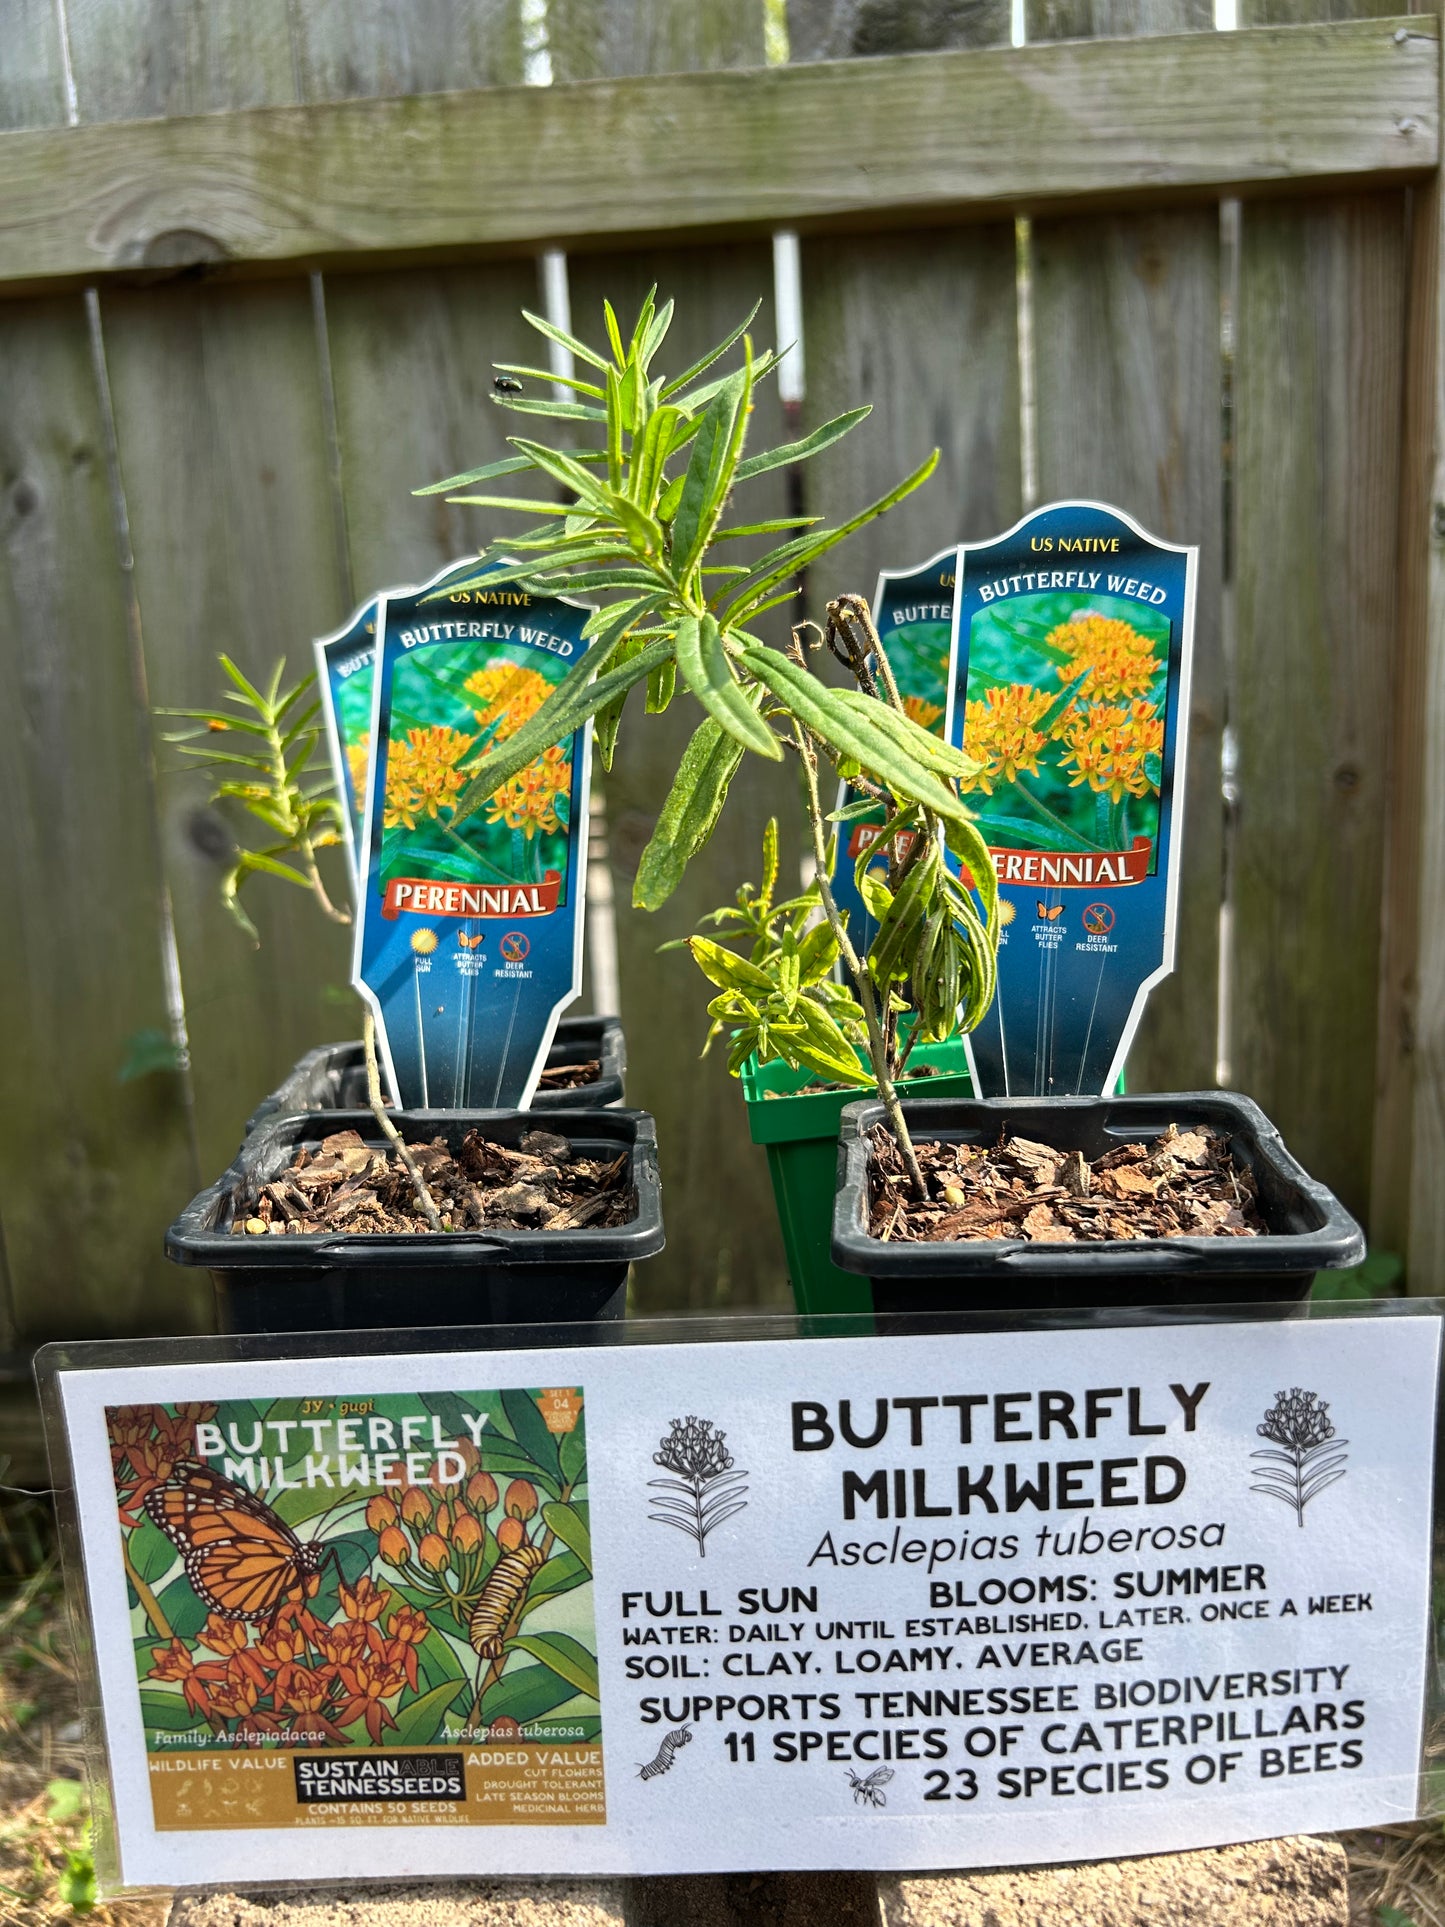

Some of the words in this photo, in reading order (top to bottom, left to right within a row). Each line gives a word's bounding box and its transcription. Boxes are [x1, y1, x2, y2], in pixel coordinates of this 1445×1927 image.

[1031, 537, 1053, 552] US
[1058, 538, 1120, 552] NATIVE
[978, 571, 1101, 603] BUTTERFLY
[1107, 576, 1167, 605] WEED
[475, 591, 531, 607] NATIVE
[892, 604, 953, 626] BUTTE
[400, 622, 515, 650] BUTTERFLY
[519, 626, 574, 657] WEED
[991, 853, 1134, 883] ERENNIAL
[395, 884, 546, 914] PERENNIAL
[1031, 925, 1067, 934] ATTRACTS
[1034, 933, 1063, 942] BUTTER
[1087, 934, 1108, 944] DEER
[1075, 942, 1118, 953] RESISTANT
[495, 968, 533, 979] RESISTANT
[505, 961, 524, 970] DEER
[553, 1398, 569, 1410] 04
[791, 1382, 1211, 1451] BUTTERFLY
[196, 1413, 490, 1456] BUTTERFLY
[223, 1450, 467, 1490] MILKWEED
[842, 1455, 1187, 1520] MILKWEED
[807, 1525, 1019, 1574] Asclepias
[1035, 1516, 1227, 1559] tuberosa
[929, 1575, 1097, 1609] BLOOMS:
[1114, 1563, 1267, 1600] SUMMER
[621, 1590, 722, 1618] FULL
[738, 1586, 818, 1615] SUN
[622, 1626, 719, 1646] WATER:
[728, 1622, 805, 1643] DAILY
[815, 1620, 894, 1641] UNTIL
[1200, 1600, 1269, 1622] ONCE
[1279, 1598, 1298, 1617] A
[1307, 1592, 1373, 1615] WEEK
[625, 1654, 710, 1680] SOIL:
[975, 1637, 1144, 1669] AVERAGE
[639, 1693, 841, 1724] SUPPORTS
[855, 1684, 1079, 1719] TENNESSEE
[1093, 1664, 1350, 1710] BIODIVERSITY
[154, 1729, 212, 1746] Family:
[440, 1723, 513, 1741] Asclepias
[518, 1723, 585, 1737] tuberosa
[723, 1731, 755, 1762] 11
[772, 1727, 949, 1762] SPECIES
[963, 1724, 1024, 1758] OF
[1040, 1700, 1366, 1754] CATERPILLARS
[150, 1758, 222, 1773] WILDLIFE
[228, 1756, 287, 1770] VALUE
[467, 1751, 529, 1767] ADDED
[535, 1751, 601, 1766] VALUE
[524, 1768, 548, 1777] CUT
[551, 1767, 603, 1777] FLOWERS
[923, 1767, 979, 1801] 23
[997, 1758, 1170, 1799] SPECIES
[1185, 1751, 1243, 1786] OF
[1259, 1739, 1364, 1778] BEES
[301, 1777, 461, 1797] TENNESSEEDS
[483, 1780, 537, 1790] DROUGHT
[542, 1779, 603, 1789] TOLERANT
[476, 1792, 506, 1802] LATE
[510, 1792, 555, 1802] SEASON
[558, 1791, 604, 1801] BLOOMS
[308, 1803, 383, 1815] CONTAINS
[388, 1802, 406, 1813] 50
[411, 1801, 457, 1813] SEEDS
[513, 1803, 572, 1813] MEDICINAL
[575, 1803, 605, 1813] HERB
